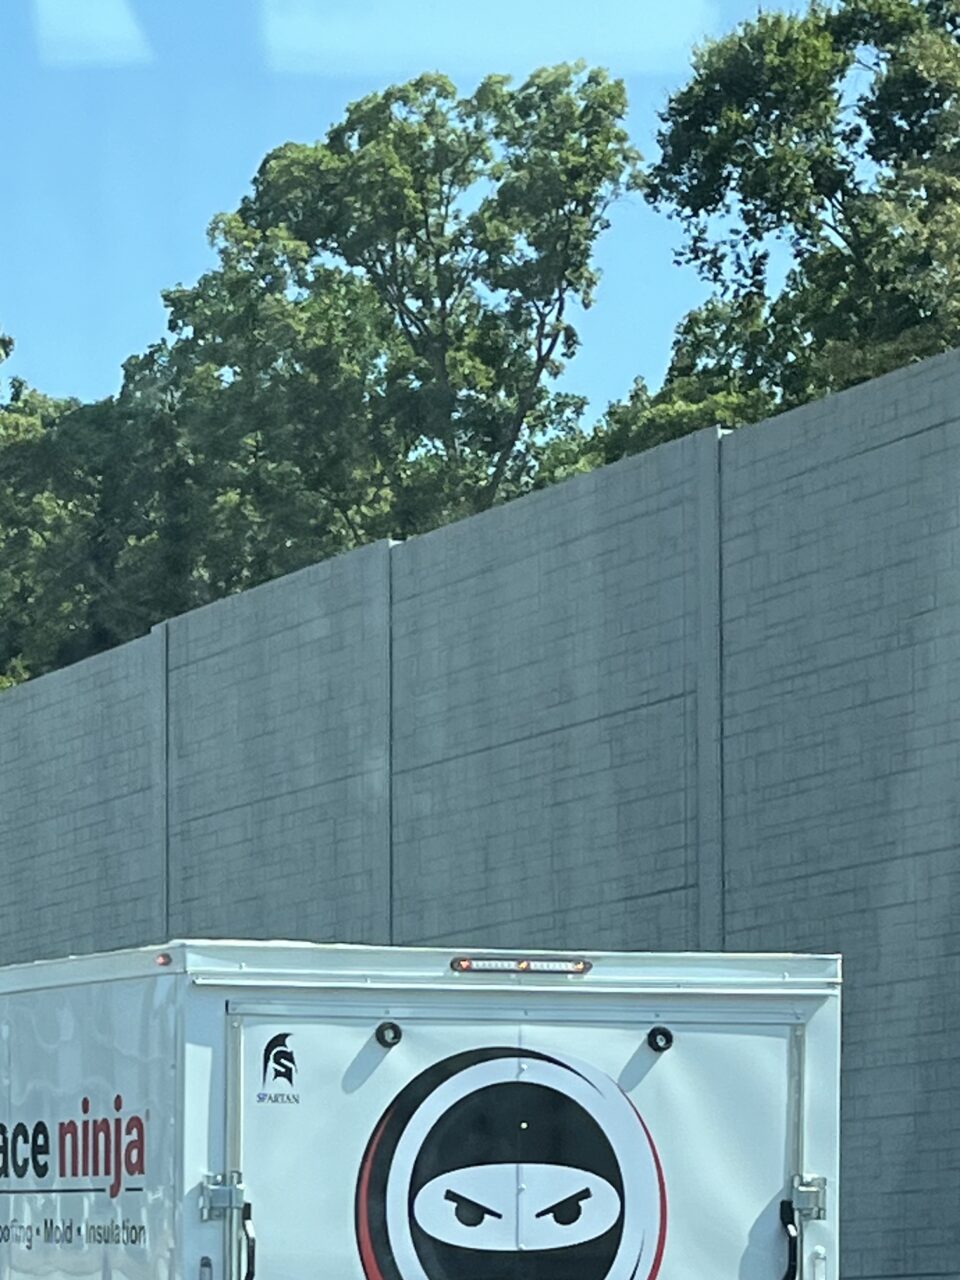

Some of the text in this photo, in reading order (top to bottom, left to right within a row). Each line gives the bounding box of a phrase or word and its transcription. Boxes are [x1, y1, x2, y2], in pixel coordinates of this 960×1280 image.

[58, 1094, 146, 1199] ninja
[43, 1218, 74, 1245] Mold
[84, 1218, 147, 1246] Insulation
